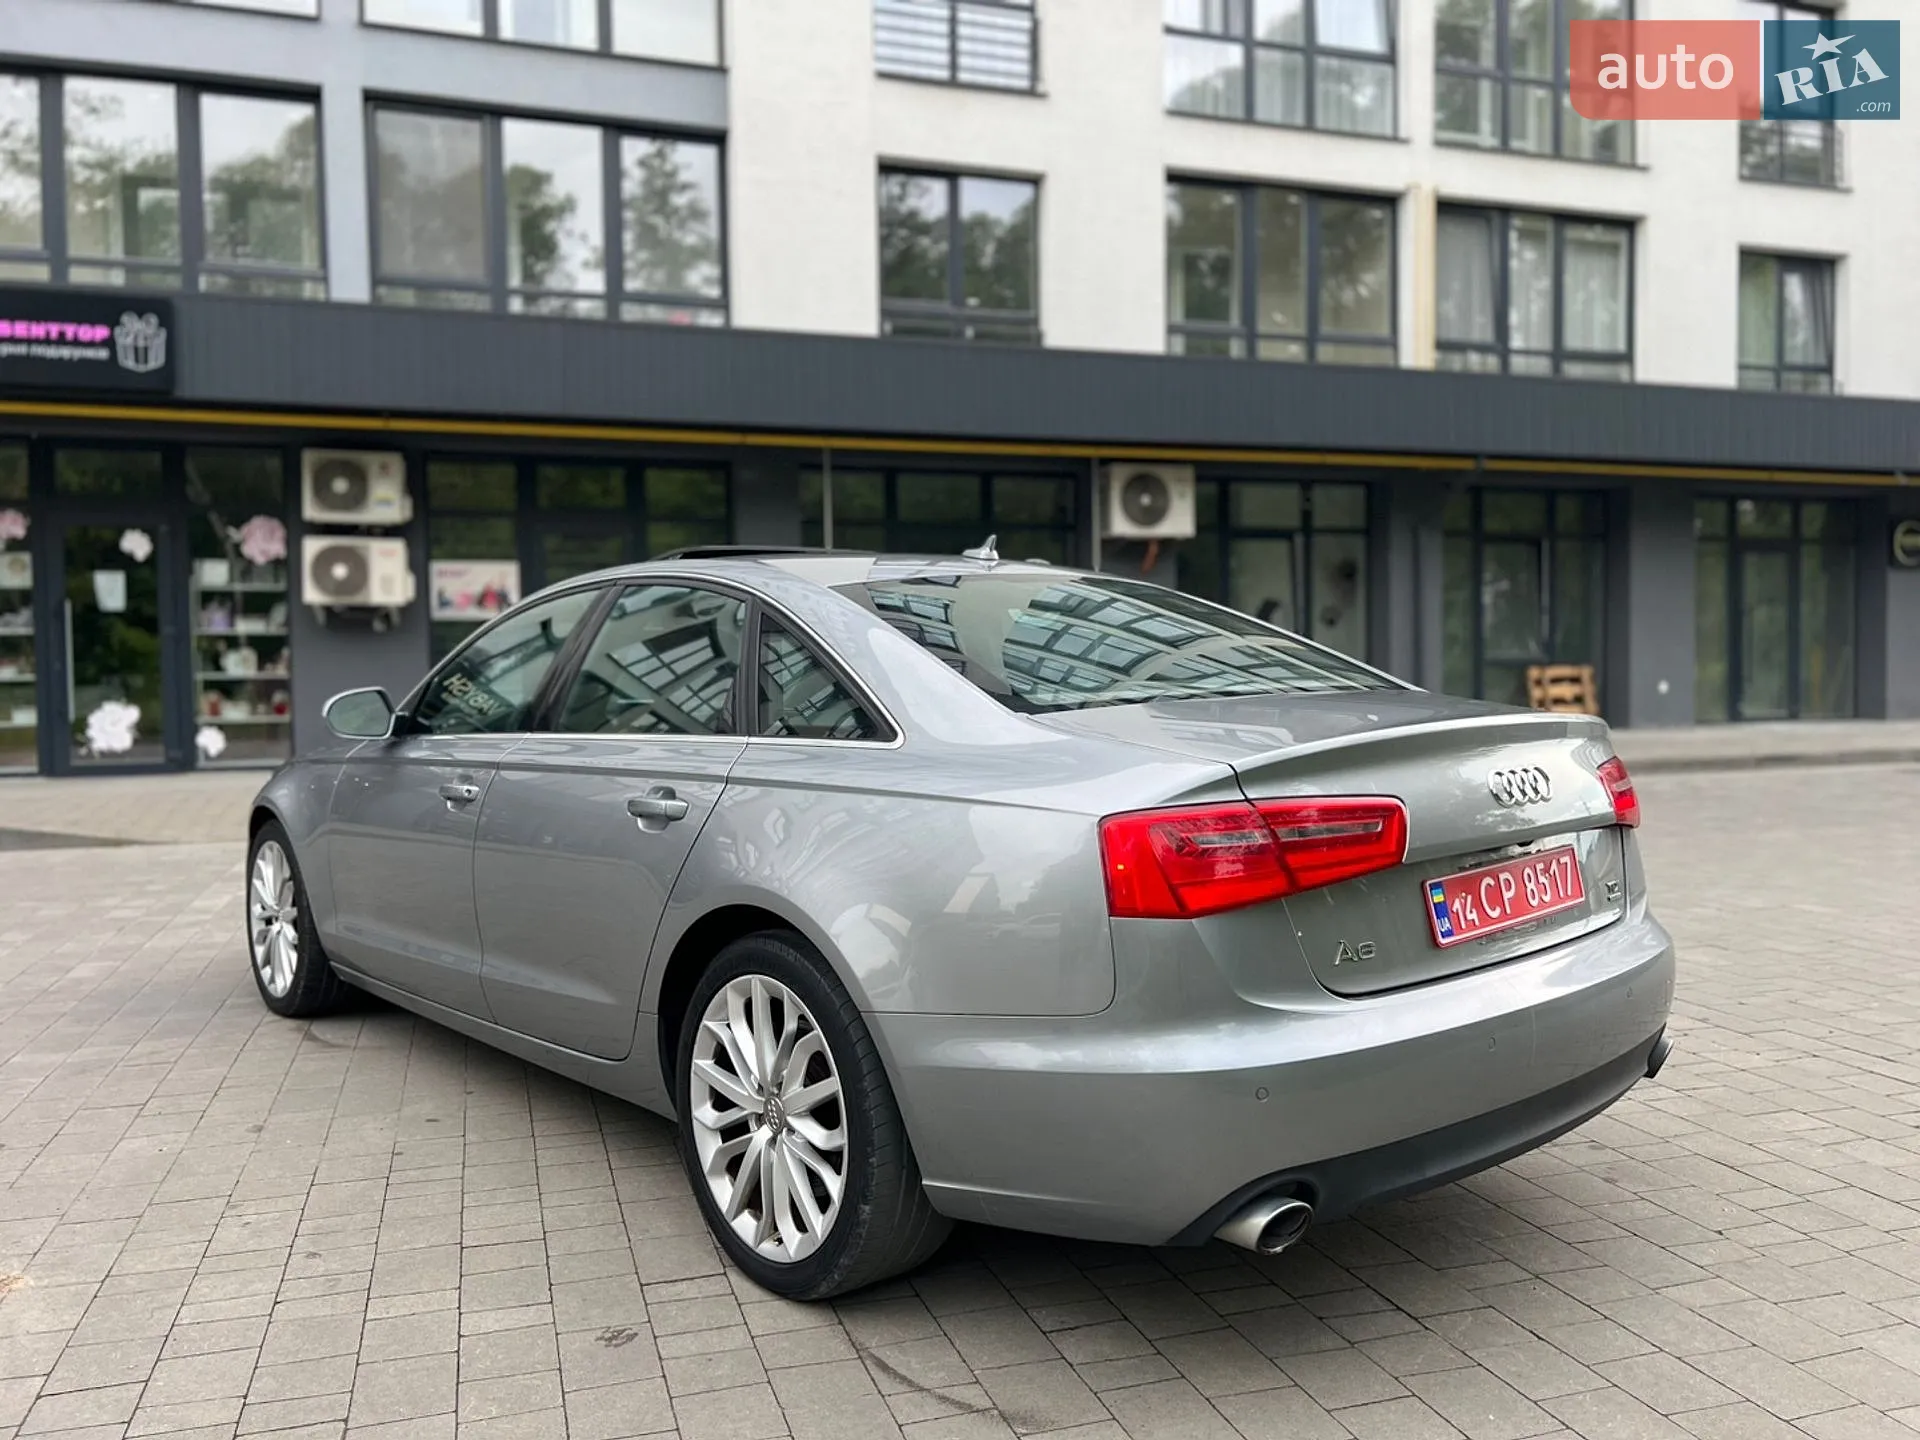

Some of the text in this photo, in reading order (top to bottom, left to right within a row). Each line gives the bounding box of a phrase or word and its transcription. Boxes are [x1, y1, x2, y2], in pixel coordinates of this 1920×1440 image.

[1452, 894, 1479, 929] 14
[1480, 871, 1516, 918] CP
[1522, 855, 1573, 907] 8517
[1437, 919, 1452, 932] UA
[1334, 940, 1376, 966] A6
